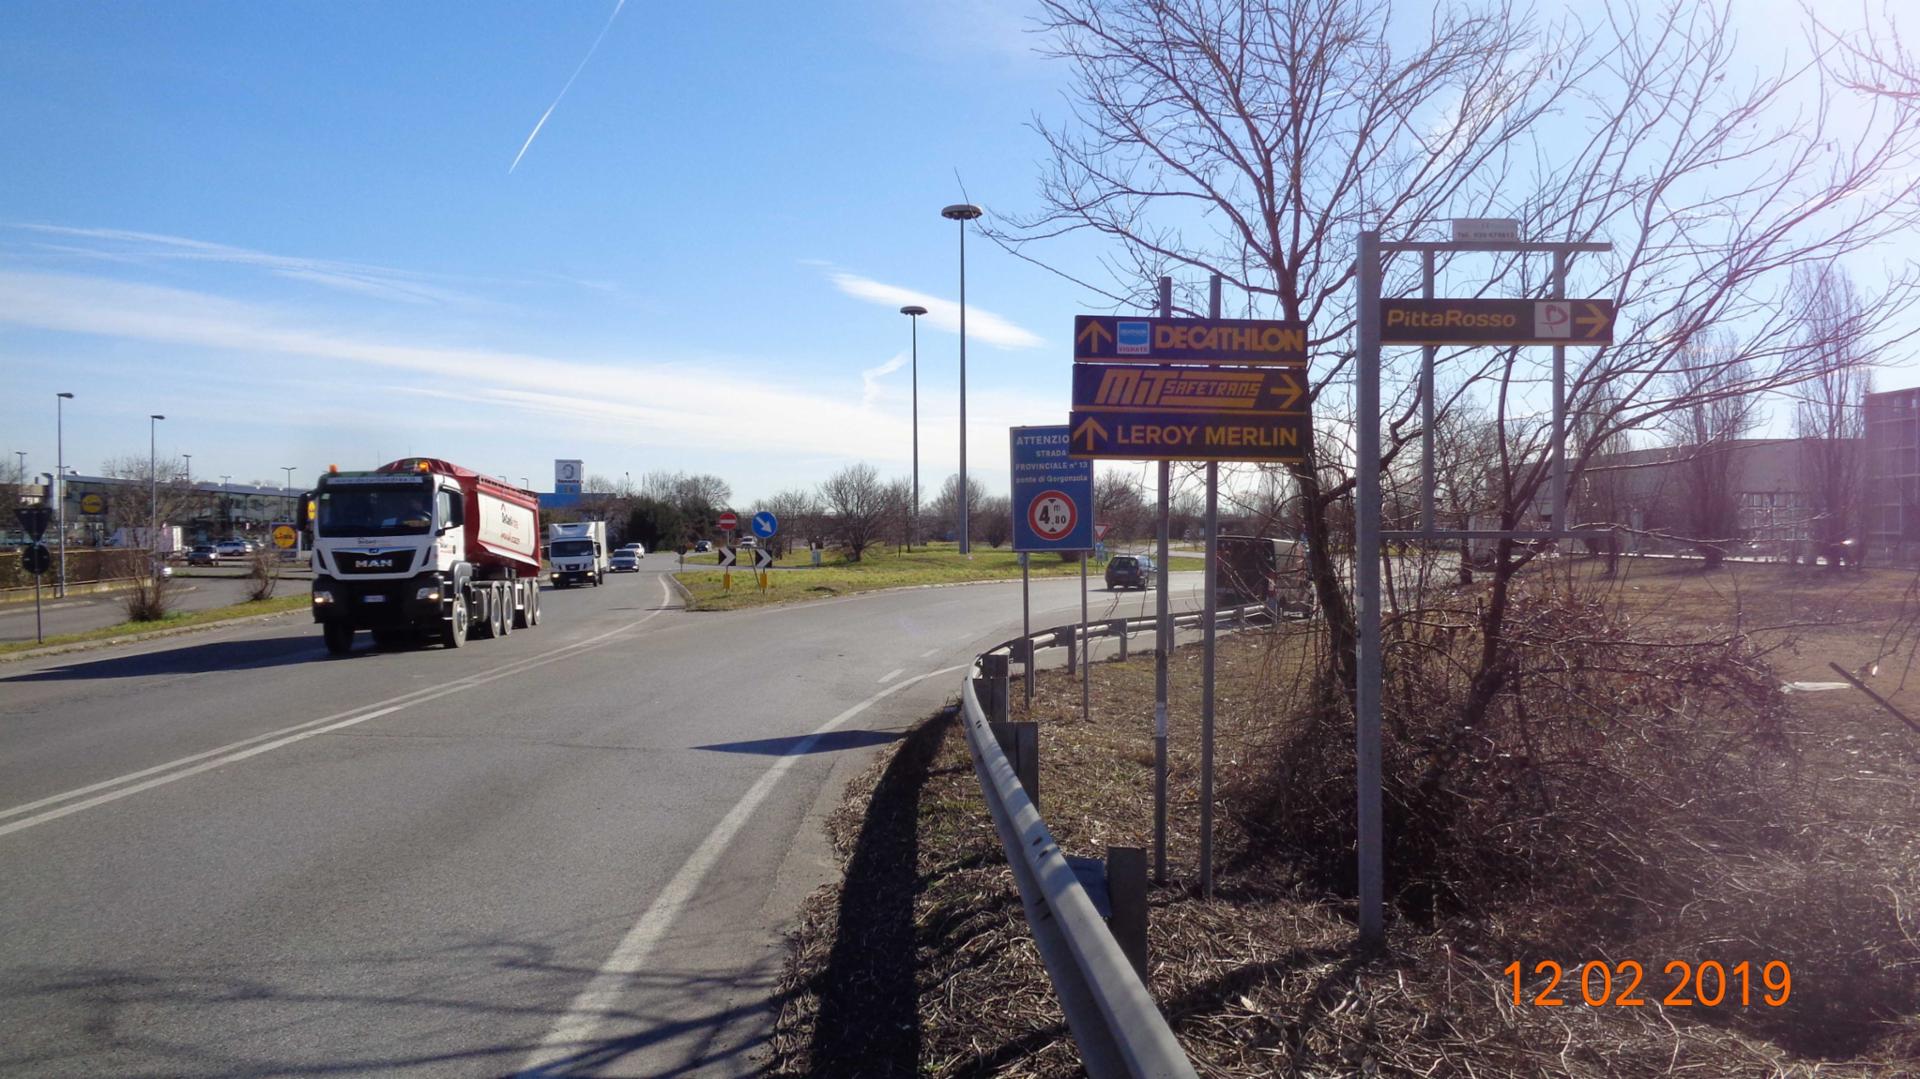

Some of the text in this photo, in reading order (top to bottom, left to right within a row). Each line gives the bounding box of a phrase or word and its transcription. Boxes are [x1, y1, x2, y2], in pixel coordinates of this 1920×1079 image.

[1387, 309, 1516, 327] PittaRosso
[1155, 325, 1303, 352] DECATHLON
[1163, 380, 1262, 397] SAFETRANS
[1016, 435, 1070, 446] ATTENZIO
[1117, 425, 1297, 446] LEROY MERLIN
[1036, 449, 1067, 457] STRADA
[1015, 462, 1068, 471] PROVINCIALE
[355, 559, 393, 568] MAN
